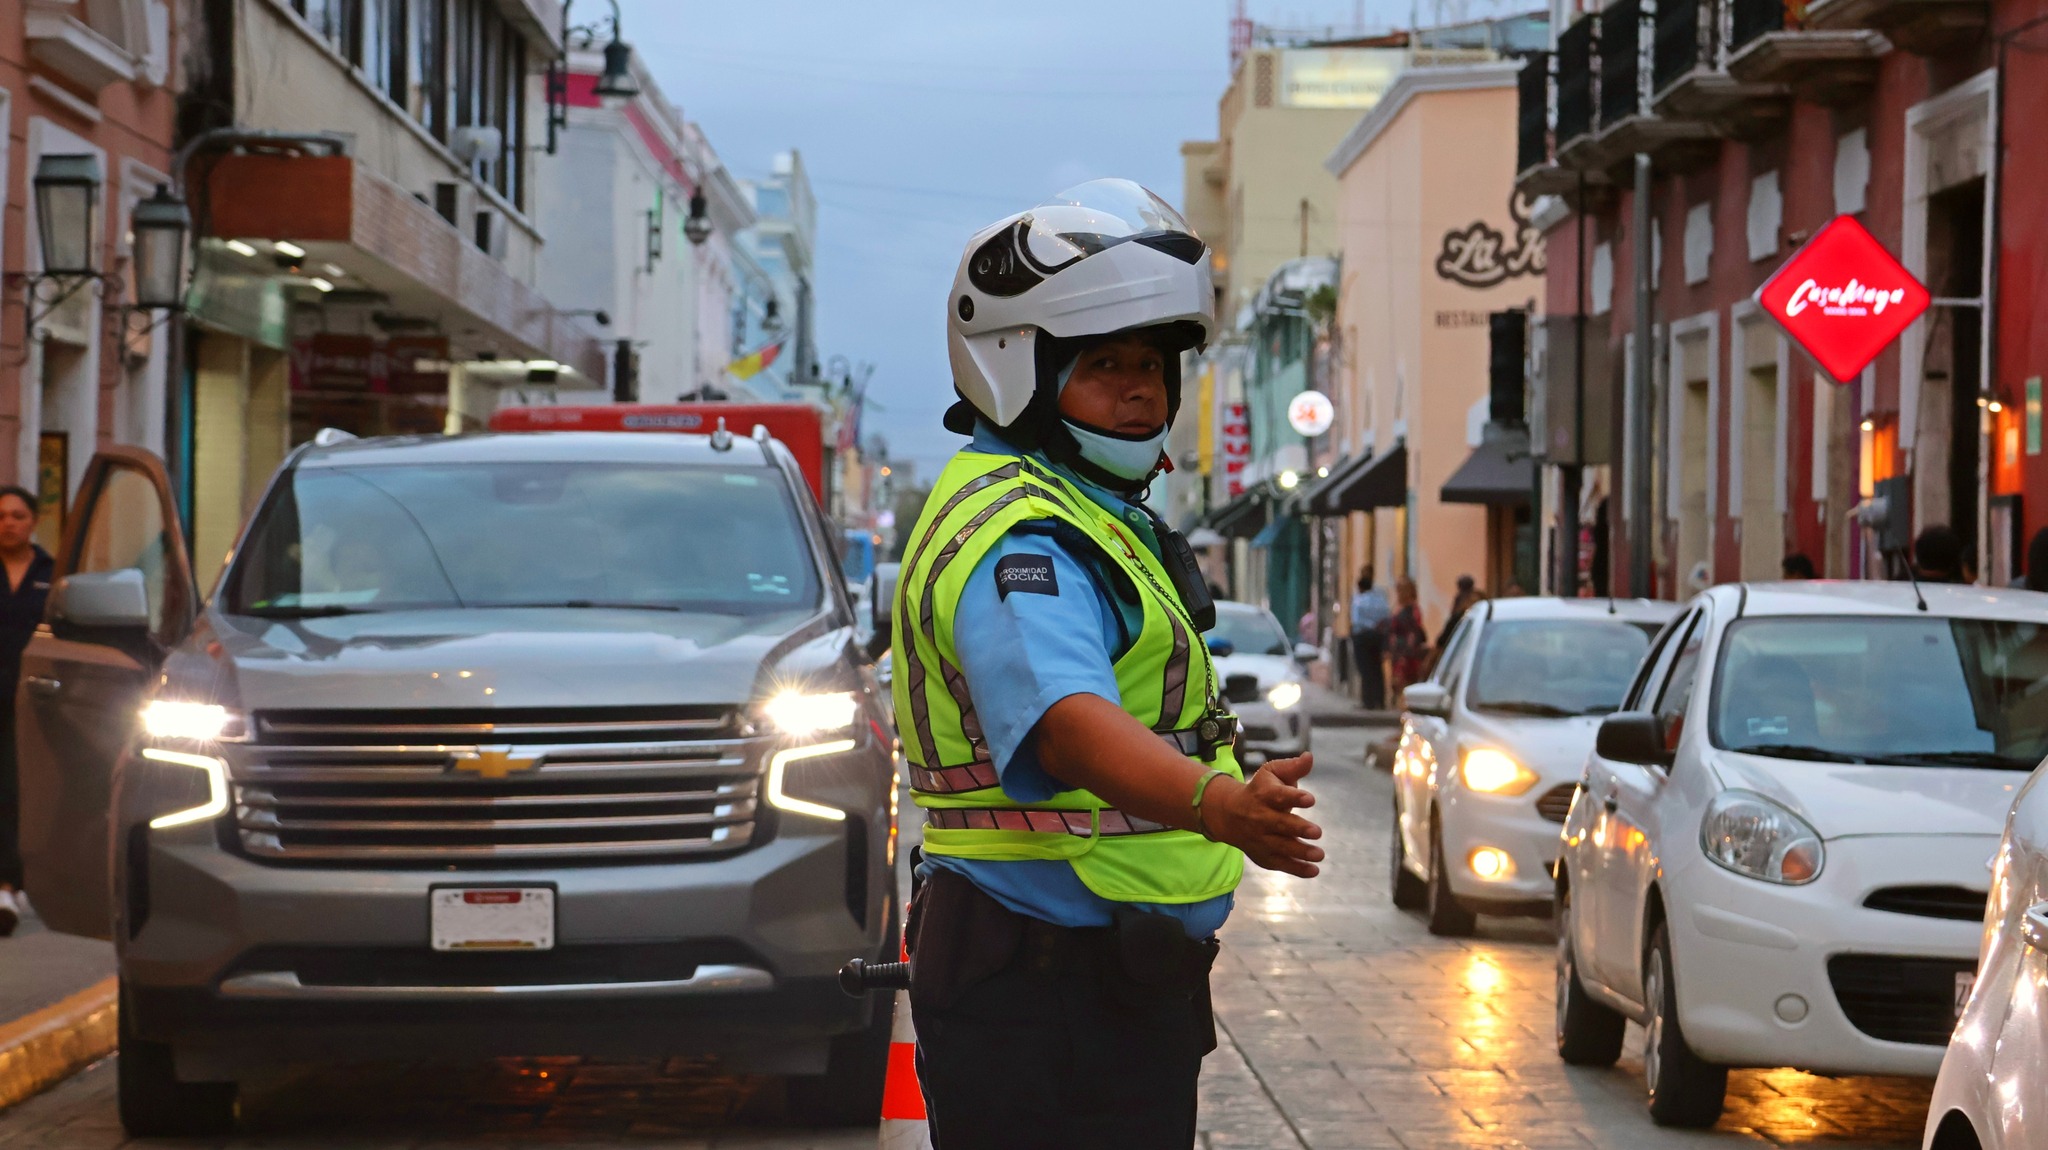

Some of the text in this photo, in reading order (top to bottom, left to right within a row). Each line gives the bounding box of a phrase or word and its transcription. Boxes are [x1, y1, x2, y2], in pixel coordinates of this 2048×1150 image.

[1439, 225, 1505, 285] La
[999, 567, 1047, 577] PROXIMIDAD
[1001, 574, 1050, 584] SOCIAL
